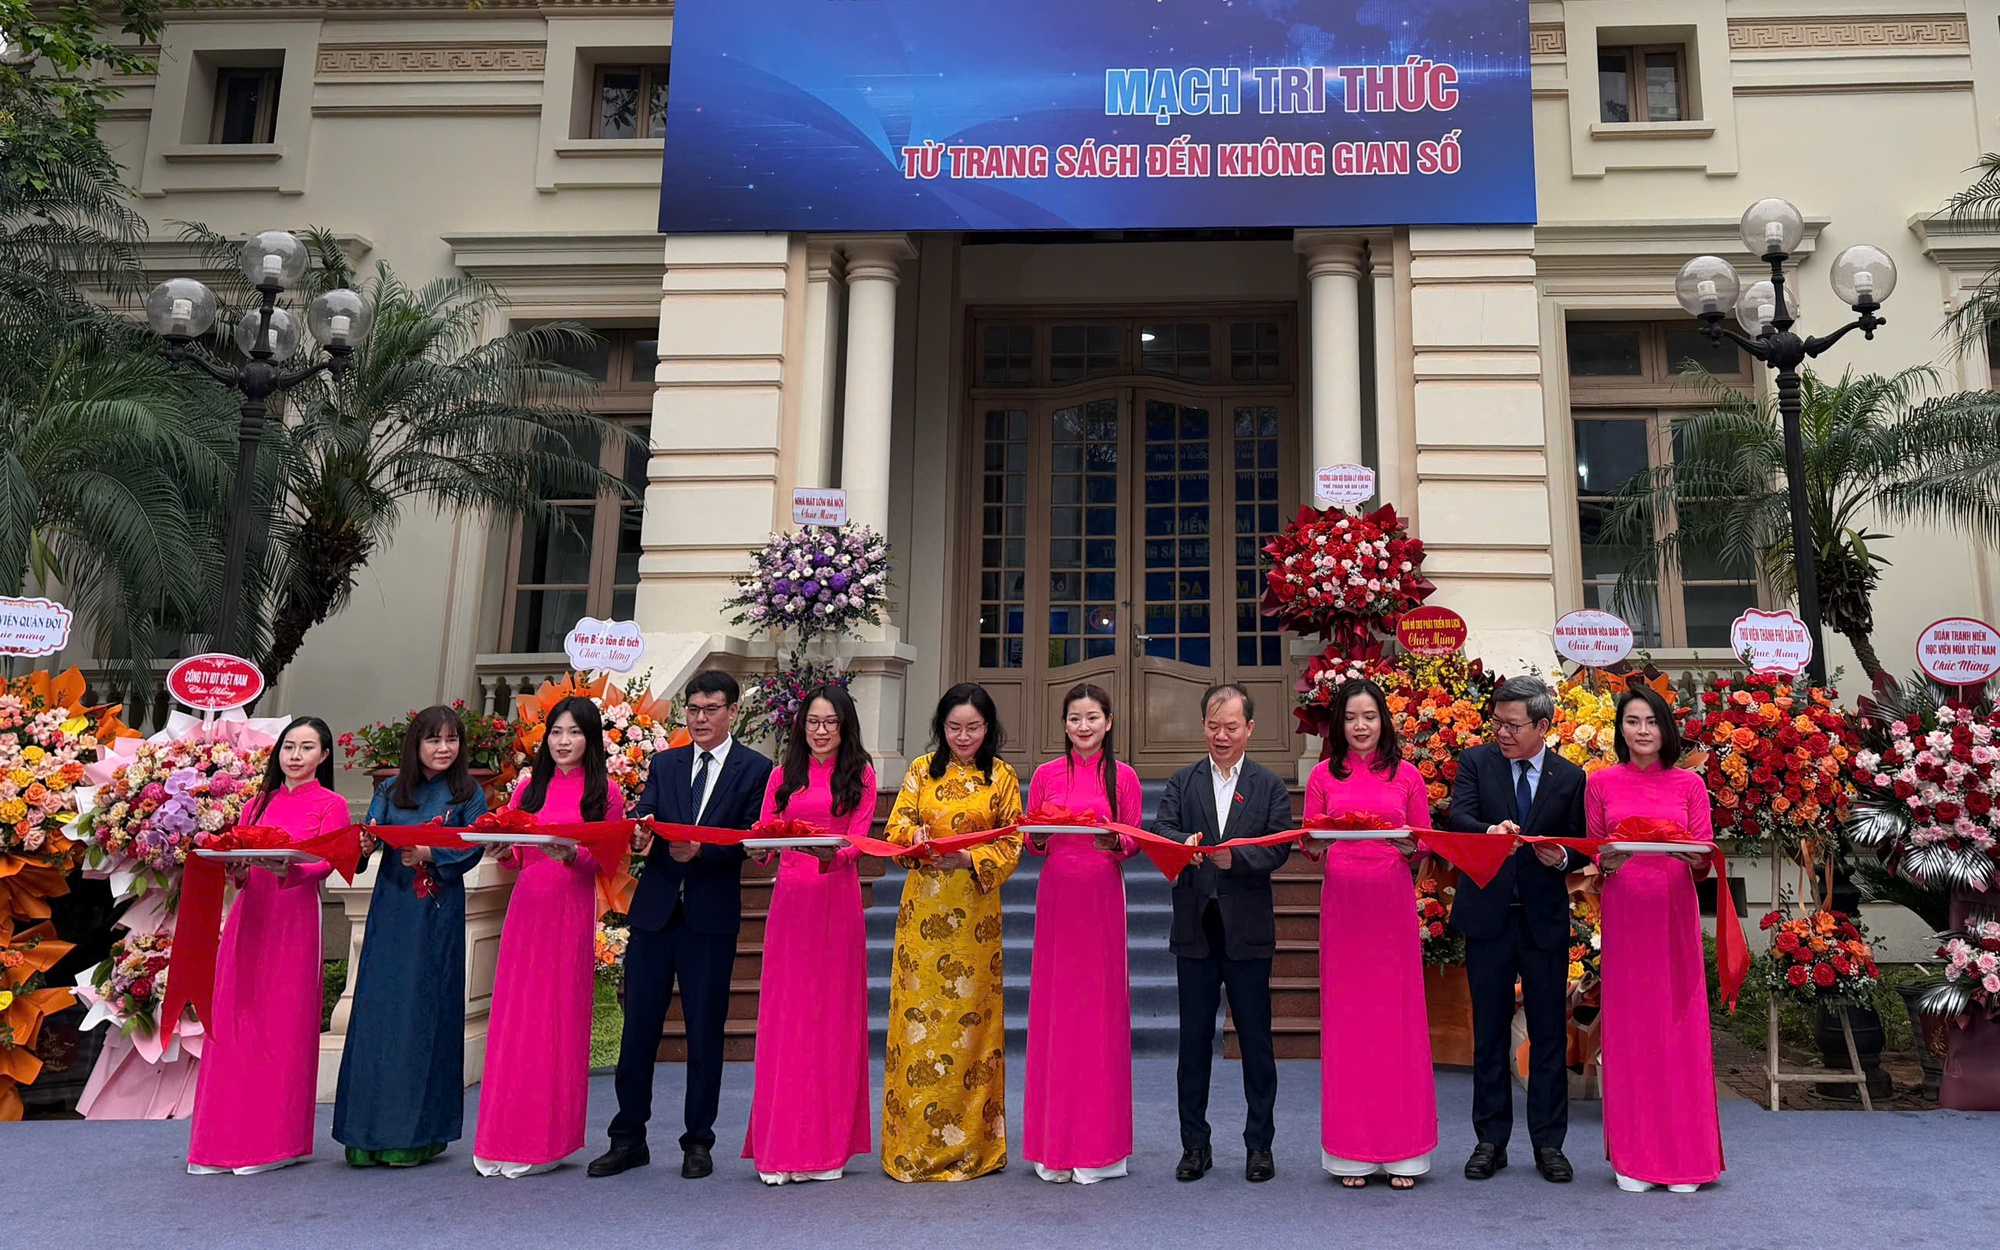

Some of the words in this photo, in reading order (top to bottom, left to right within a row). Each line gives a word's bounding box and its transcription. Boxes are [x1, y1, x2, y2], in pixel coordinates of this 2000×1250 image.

[1105, 68, 1242, 126] MẠCH
[1253, 66, 1325, 114] TRI
[1337, 56, 1459, 112] THỨC
[902, 141, 944, 179] TỪ
[947, 145, 1048, 178] TRANG
[1055, 139, 1139, 178] SÁCH
[1145, 135, 1210, 178] ĐẾN
[1217, 137, 1326, 176] KHÔNG
[1332, 142, 1410, 175] GIAN
[1415, 130, 1462, 174] SỐ
[574, 633, 588, 646] Viện
[590, 633, 604, 645] Bo
[1408, 632, 1430, 646] Chúc
[1432, 632, 1456, 647] Mừng
[1951, 631, 1971, 641] THANH
[1568, 640, 1590, 650] Chúc
[1591, 640, 1618, 652] Mừng
[1982, 646, 1996, 656] NAM
[579, 648, 600, 658] Chúc
[1932, 660, 1956, 670] Chúc
[1958, 660, 1990, 674] Mừng
[202, 672, 210, 684] TY
[234, 674, 248, 686] NAM
